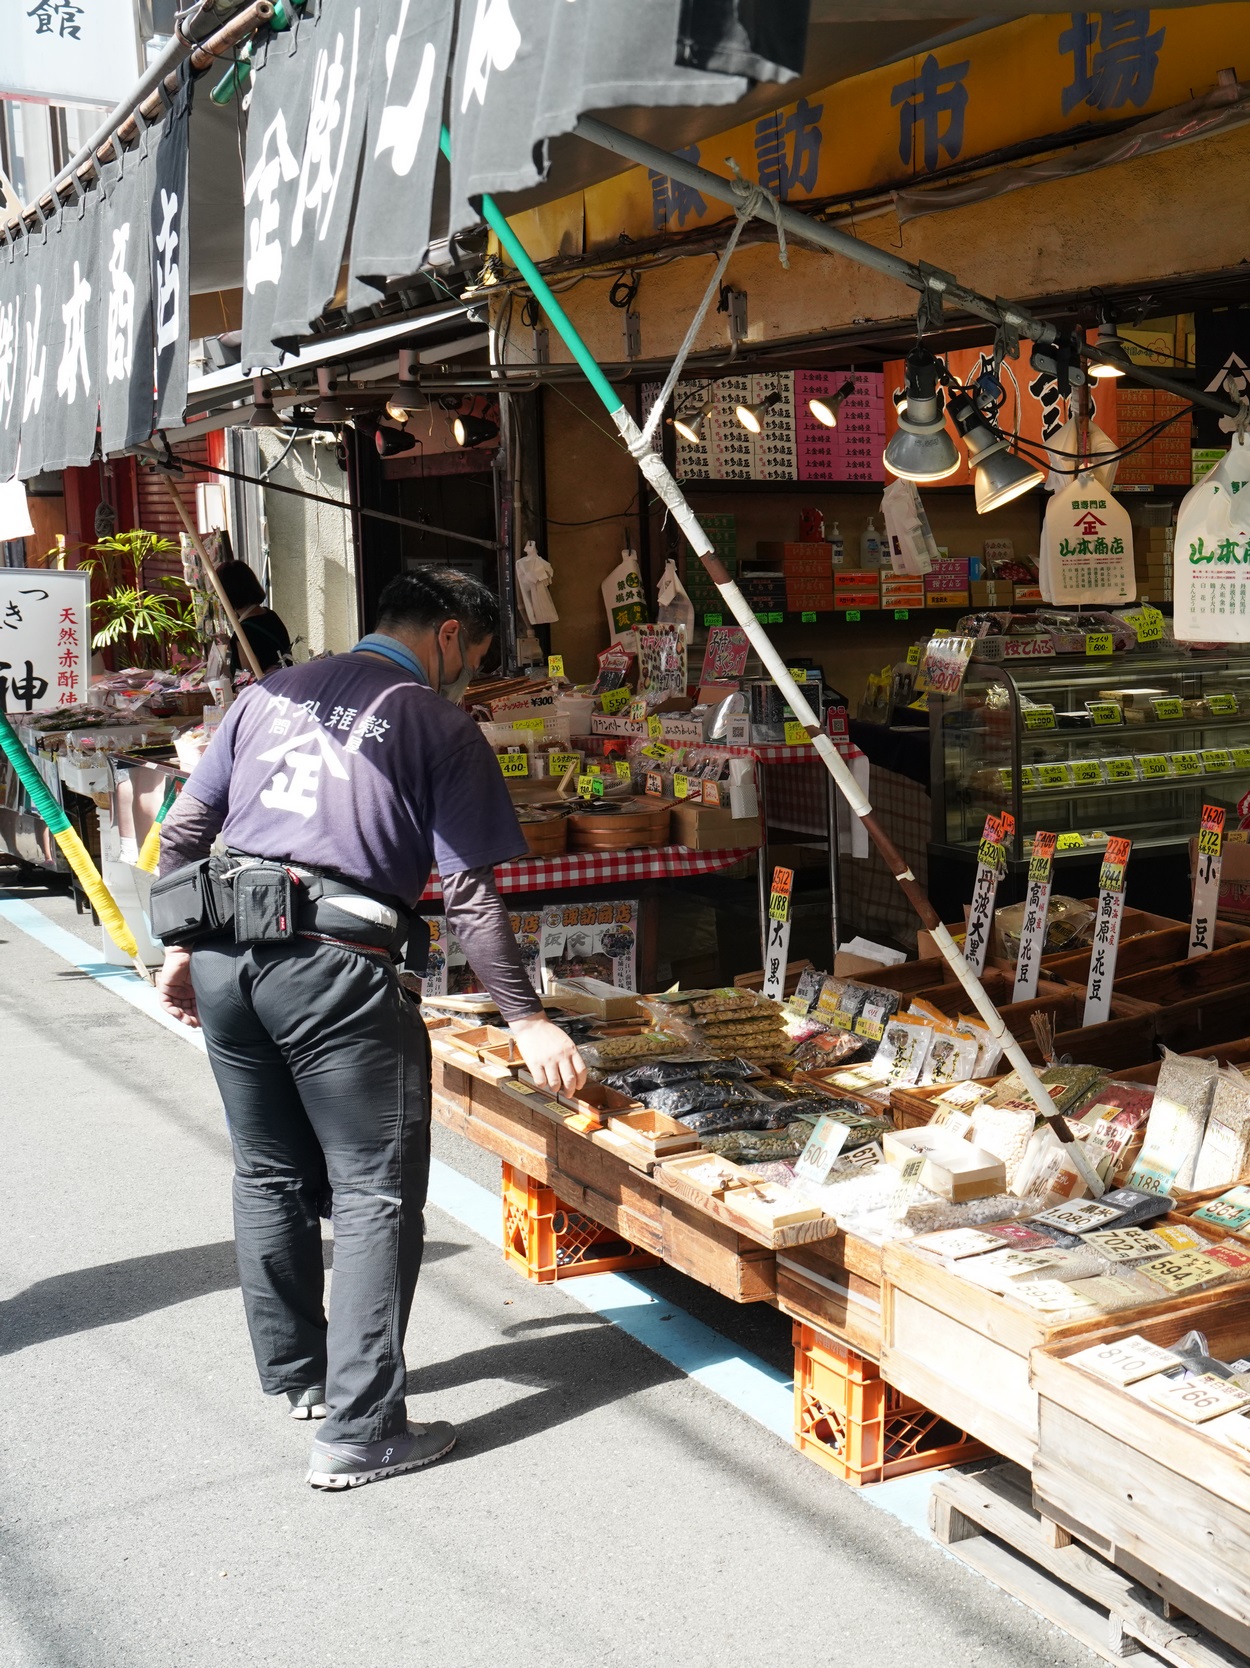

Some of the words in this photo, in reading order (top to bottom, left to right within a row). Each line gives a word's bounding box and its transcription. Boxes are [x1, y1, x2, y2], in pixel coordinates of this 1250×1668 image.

[27, 0, 84, 41] 館
[647, 8, 1167, 232] 諏訪市場
[1070, 500, 1107, 511] 豆専門店
[1059, 536, 1125, 557] 山本商店
[264, 693, 391, 743] 内外雑穀
[1199, 830, 1220, 847] 972
[562, 904, 633, 927] 諏訪商店
[1191, 856, 1217, 950] 小豆
[965, 869, 994, 967] 丹波大黒
[1017, 882, 1041, 984] 高原花豆
[1088, 891, 1114, 1002] 高原花豆
[768, 920, 784, 1000] 大黒
[1096, 1120, 1125, 1138] ひまわり
[1048, 1207, 1093, 1226] 1,080
[1077, 1203, 1114, 1219] 黒米
[1123, 1229, 1162, 1256] はと麦
[1097, 1346, 1147, 1372] 810
[1169, 1382, 1221, 1409] 766
